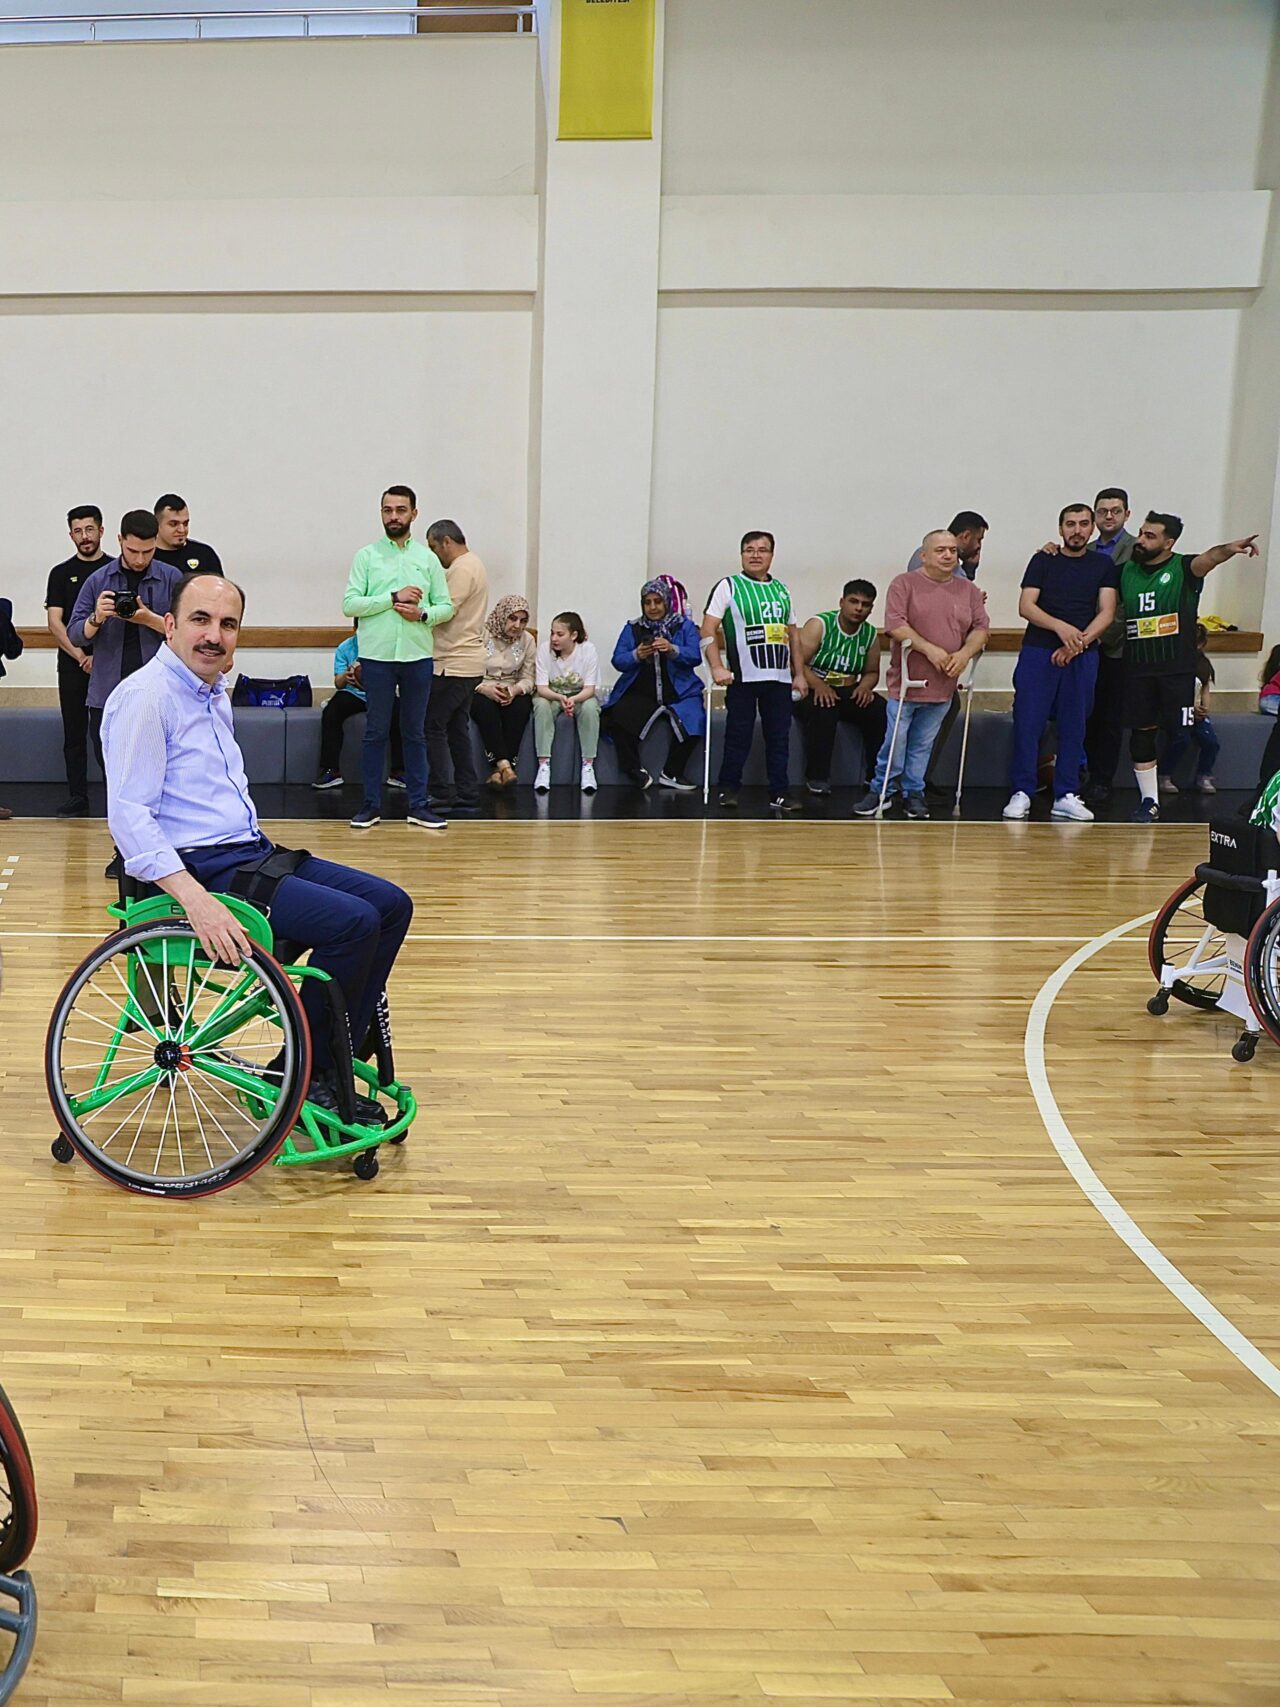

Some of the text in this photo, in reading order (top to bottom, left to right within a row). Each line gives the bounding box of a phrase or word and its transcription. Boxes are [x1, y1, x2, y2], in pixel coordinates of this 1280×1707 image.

[761, 601, 782, 618] 26
[1138, 591, 1156, 612] 15
[834, 655, 850, 672] 14
[1181, 706, 1195, 726] 15
[1211, 831, 1237, 849] EXTRA
